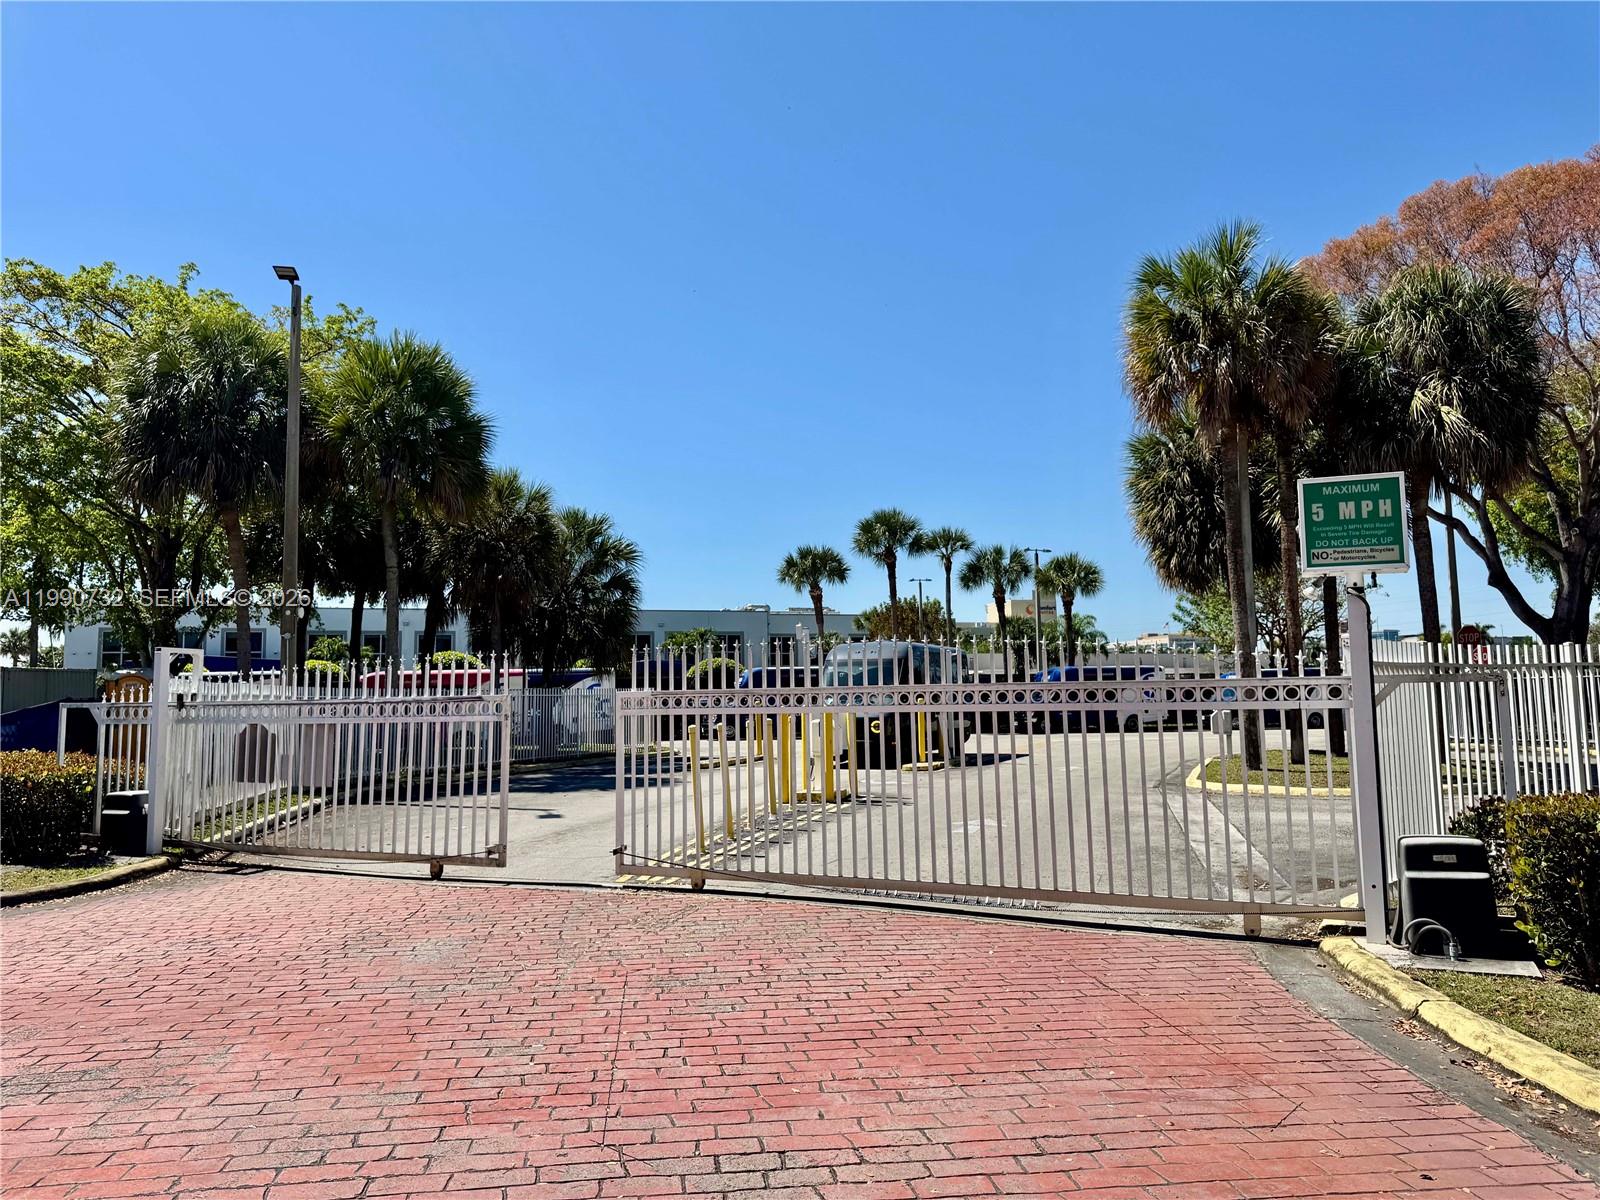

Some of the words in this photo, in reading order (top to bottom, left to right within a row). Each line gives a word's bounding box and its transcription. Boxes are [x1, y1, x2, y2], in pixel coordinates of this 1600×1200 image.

[1322, 483, 1380, 495] MAXIMUM
[1311, 503, 1324, 522] 5
[1338, 498, 1392, 520] MPH
[1331, 538, 1350, 547] NOT
[1352, 537, 1378, 546] BACK
[1380, 536, 1393, 544] UP
[1312, 551, 1333, 561] NO:
[1459, 632, 1480, 643] STOP
